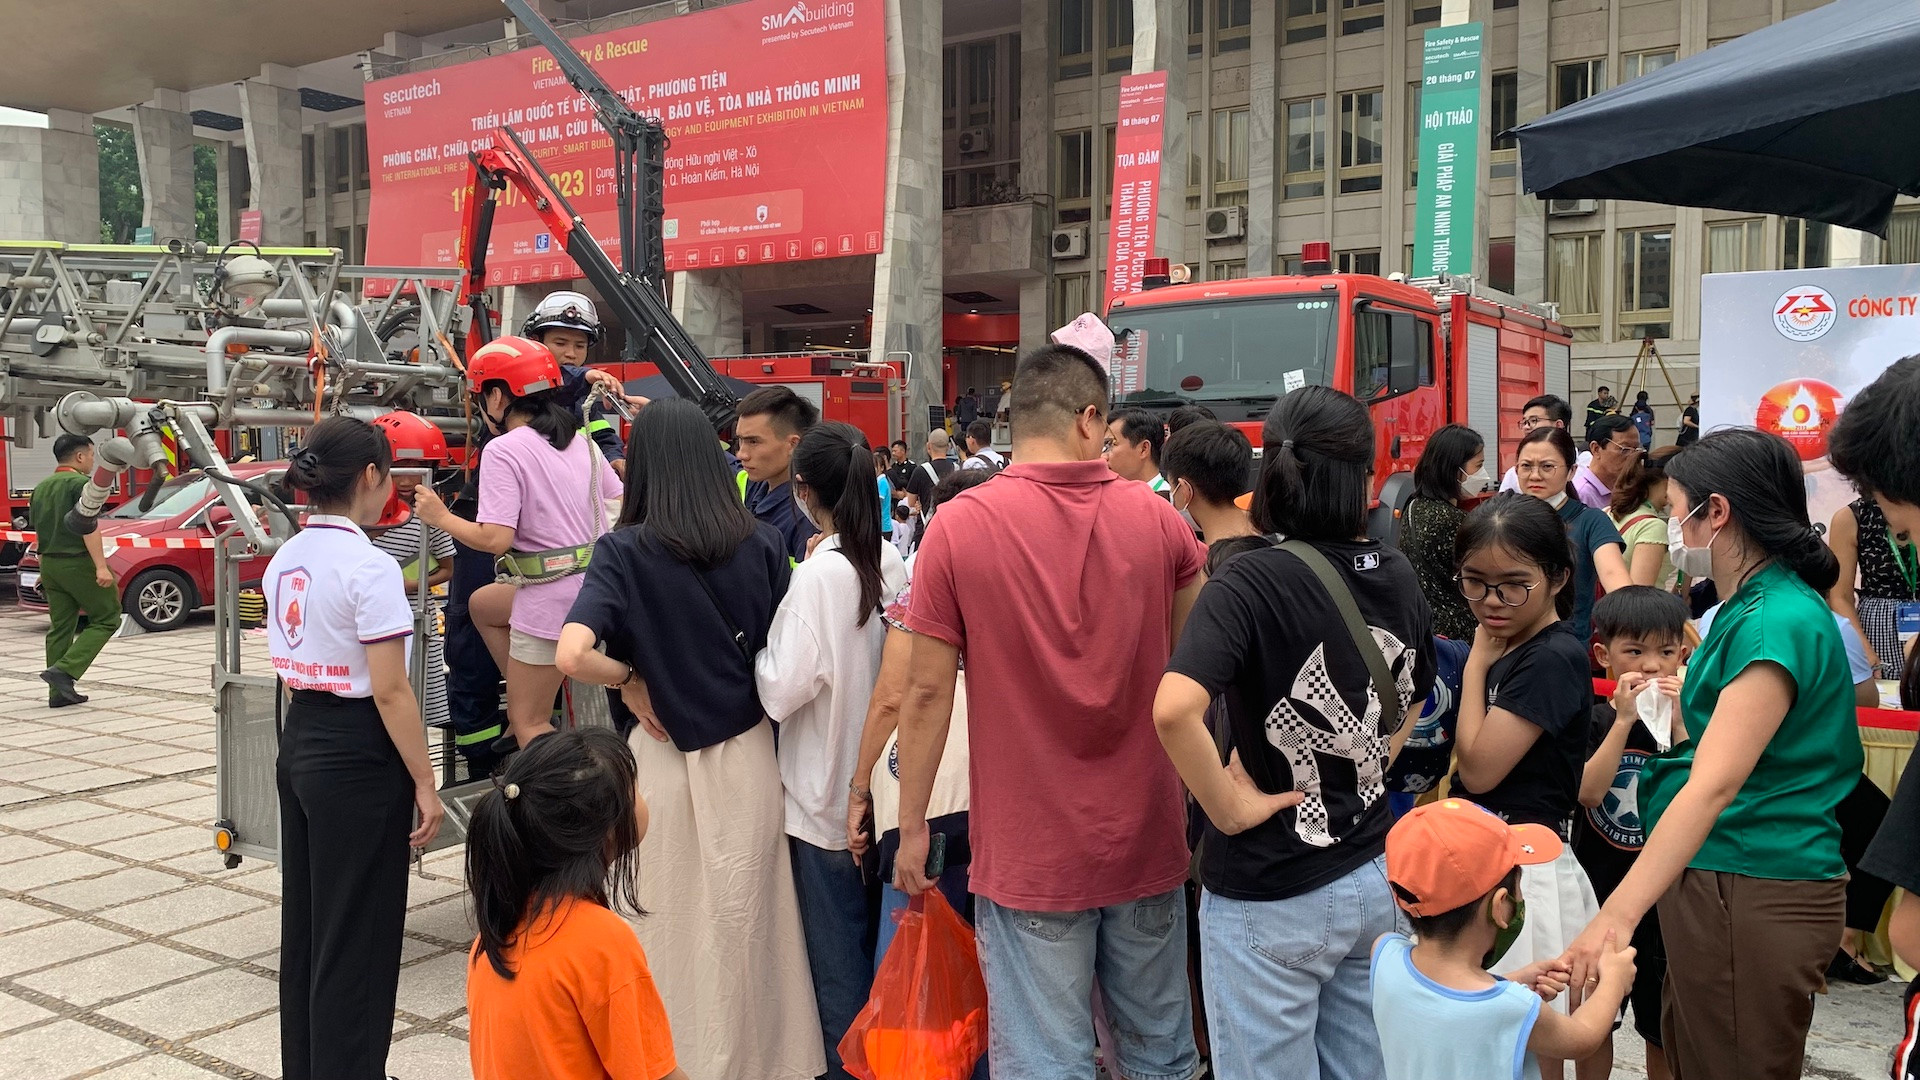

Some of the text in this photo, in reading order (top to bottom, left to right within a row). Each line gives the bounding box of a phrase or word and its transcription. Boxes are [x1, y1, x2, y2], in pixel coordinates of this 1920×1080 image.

[762, 20, 854, 46] presented by Secutech Vietnam
[1436, 38, 1454, 46] Safety
[1460, 35, 1480, 43] Rescue
[532, 57, 553, 75] Fire
[594, 43, 604, 62] &
[606, 38, 648, 59] Rescue
[1425, 53, 1449, 61] secutech
[533, 76, 566, 90] VIETNAM
[1426, 70, 1476, 85] 20 tháng 07
[383, 78, 441, 105] secutech
[471, 109, 499, 131] TRIỂN
[503, 107, 523, 126] LÃM
[526, 100, 555, 123] QUỐC
[557, 95, 571, 116] TẾ
[573, 94, 587, 113] VỀ
[649, 77, 697, 100] PHƯƠNG
[700, 69, 727, 92] TIỆN
[383, 150, 412, 168] PHÒNG
[414, 144, 441, 162] CHÁY,
[443, 140, 469, 158] CHỮA
[539, 124, 563, 143] NẠN,
[566, 117, 588, 138] CỨU
[668, 100, 692, 120] BẢO
[696, 96, 715, 117] VỆ,
[719, 91, 742, 112] TÒA
[746, 86, 772, 108] NHÀ
[776, 80, 819, 103] THÔNG
[824, 73, 860, 95] MINH
[384, 106, 412, 119] VIETNAM
[1122, 114, 1160, 127] 19 tháng 07
[1424, 106, 1473, 131] HỘI THẢO
[382, 173, 393, 183] THE
[394, 166, 442, 181] INTERNATIONAL
[444, 164, 458, 176] FIRE
[529, 145, 560, 160] ECURITY,
[563, 141, 589, 155] SMART
[591, 137, 613, 151] BUILD
[684, 123, 702, 135] AND
[704, 114, 755, 133] EQUIPMENT
[756, 107, 806, 125] EXHIBITION
[810, 104, 819, 116] IN
[822, 97, 865, 114] VIETNAM
[596, 166, 614, 180] Cung
[685, 152, 702, 166] Hữu
[703, 150, 721, 166] nghị
[722, 148, 739, 161] Việt
[745, 145, 757, 158] Xô
[1117, 149, 1160, 169] TỌA ĐÀM
[596, 184, 605, 196] 91
[670, 174, 679, 187] Q.
[681, 171, 702, 185] Hoàn
[704, 168, 728, 182] Kiếm,
[731, 166, 743, 178] Hà
[745, 163, 760, 177] Nội
[1136, 180, 1152, 222] PHƯƠNG
[1432, 142, 1458, 272] GIẢI PHÁP AN NINH THÔNG
[1112, 181, 1136, 292] THÀNH TỰU CỦA CUỘC
[1132, 225, 1150, 248] TIỆN
[1131, 251, 1147, 278] PCCC
[1848, 294, 1918, 317] CÔNG TY
[1124, 365, 1138, 392] MINH
[326, 665, 350, 676] NAM
[1603, 824, 1644, 845] LIBERT
